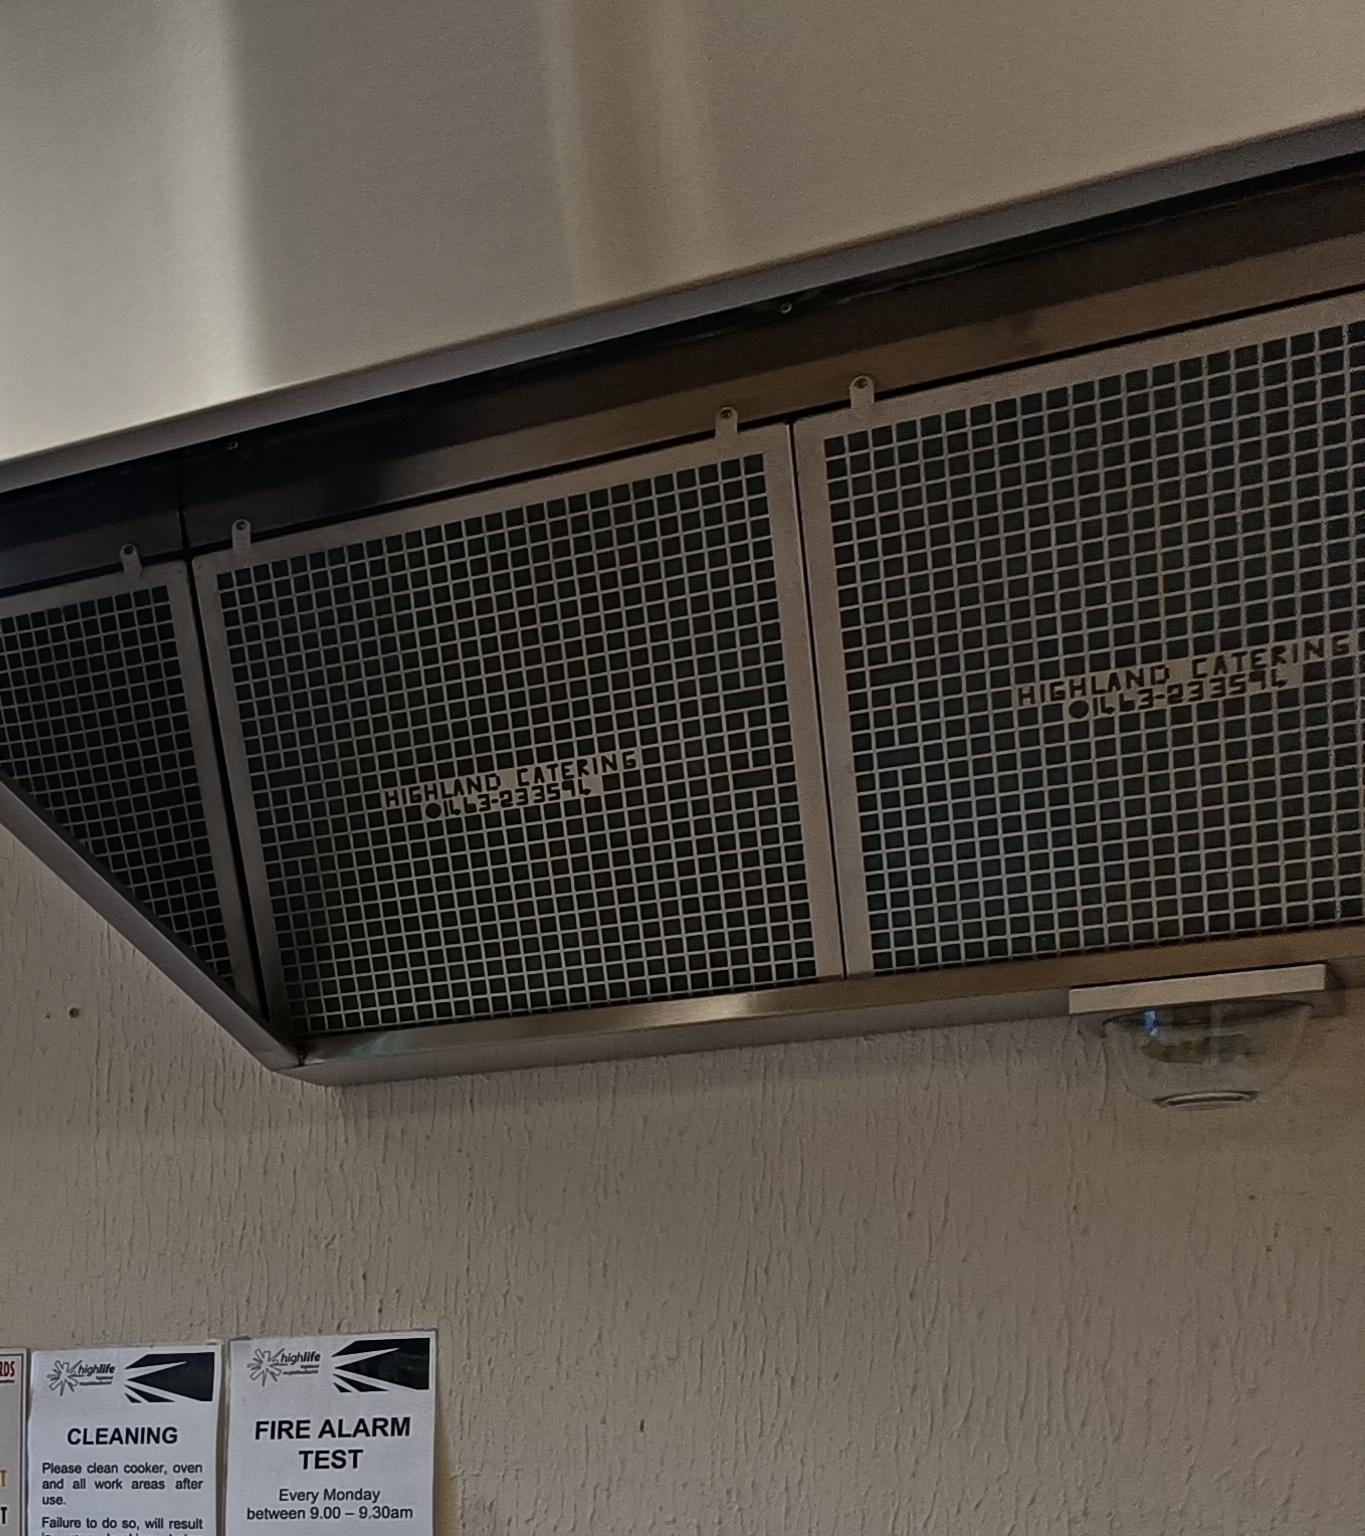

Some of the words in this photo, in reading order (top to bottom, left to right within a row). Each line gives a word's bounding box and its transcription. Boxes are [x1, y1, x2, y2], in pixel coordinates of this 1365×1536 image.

[1019, 665, 1169, 706] HIGHLAND
[1192, 634, 1351, 679] CATERING
[384, 773, 501, 808] HIGHLAND
[517, 750, 637, 787] CATERING
[280, 1351, 321, 1365] highlife
[77, 1364, 116, 1376] highlife
[67, 1426, 178, 1446] CLEANING
[255, 1420, 310, 1440] FIRE
[317, 1417, 411, 1438] ALARM
[299, 1449, 364, 1470] TEST
[42, 1462, 82, 1475] Please
[87, 1463, 119, 1474] clean
[123, 1463, 168, 1476] cooker,
[172, 1464, 203, 1474] oven
[42, 1495, 66, 1506] use.
[279, 1489, 319, 1503] Every
[322, 1488, 381, 1503] Monday
[247, 1506, 306, 1519] between
[310, 1506, 341, 1519] 9.00
[358, 1506, 413, 1519] 9.30am
